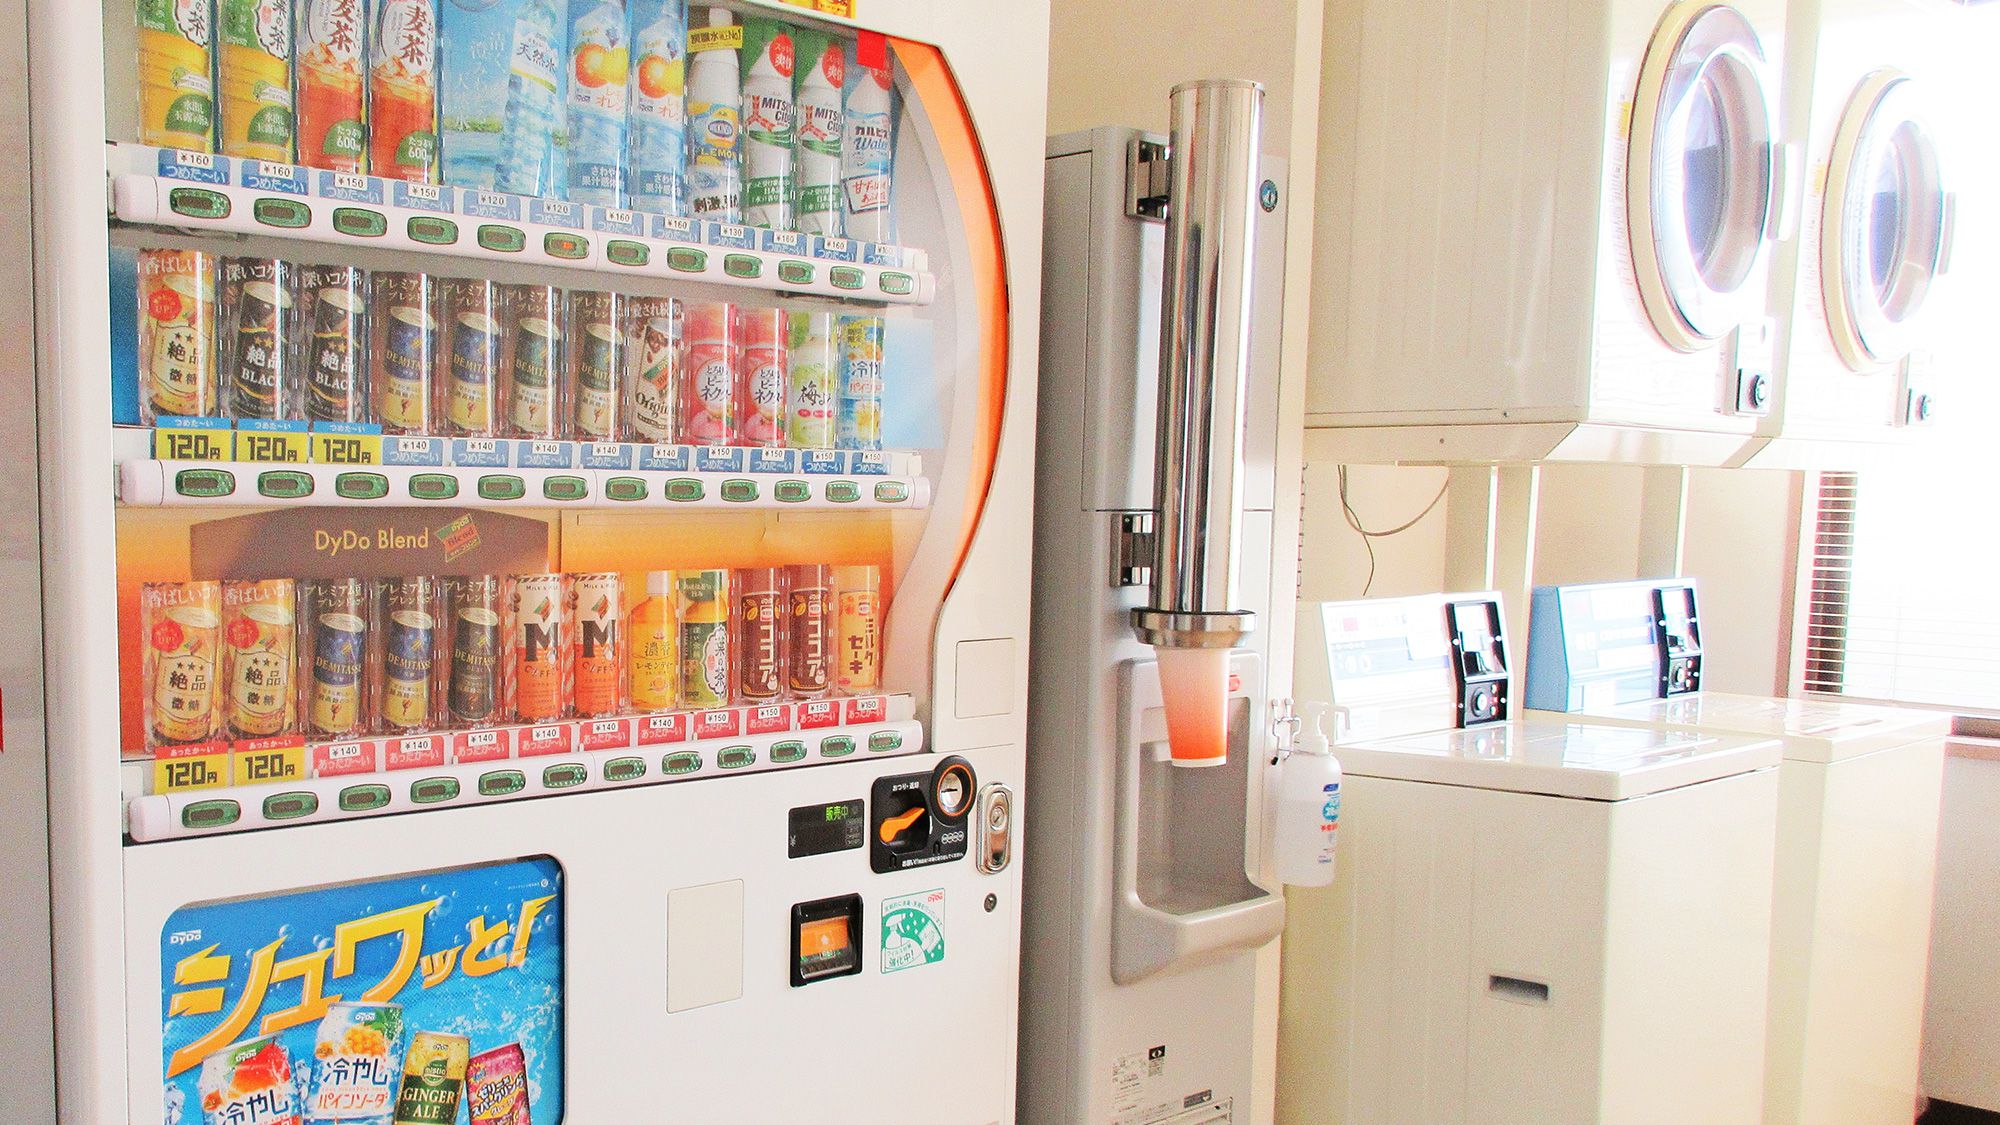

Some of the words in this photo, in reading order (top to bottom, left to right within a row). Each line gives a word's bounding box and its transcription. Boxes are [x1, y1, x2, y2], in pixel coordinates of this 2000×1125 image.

[399, 5, 427, 66] 麦茶
[180, 153, 210, 166] ¥160
[263, 165, 291, 178] ¥160
[338, 178, 364, 189] ¥150
[412, 186, 437, 198] ¥150
[481, 196, 505, 206] ¥120
[546, 203, 569, 213] ¥120
[609, 212, 630, 222] ¥160
[667, 220, 688, 230] ¥160
[722, 227, 743, 237] ¥130
[827, 241, 845, 250] ¥160
[241, 367, 276, 387] BLAC
[316, 371, 350, 391] BLAC
[167, 433, 221, 461] 120円
[247, 436, 298, 462] 120円
[323, 438, 371, 464] 120円
[402, 441, 427, 451] ¥140
[469, 442, 493, 452] ¥140
[535, 444, 557, 453] ¥140
[595, 446, 617, 455] ¥140
[711, 447, 730, 457] ¥150
[655, 448, 676, 458] ¥140
[764, 449, 783, 458] ¥150
[814, 451, 834, 461] ¥150
[315, 530, 370, 556] DyDo
[378, 527, 429, 549] Blend
[524, 622, 559, 662] M
[581, 619, 616, 658] M
[759, 624, 774, 683] ココア
[807, 620, 822, 677] ココア
[848, 635, 864, 675] セーキ
[169, 670, 207, 691] 絶品
[245, 666, 281, 686] 絶品
[760, 708, 778, 717] ¥150
[810, 704, 828, 712] ¥150
[596, 723, 616, 732] ¥140
[652, 718, 672, 727] ¥140
[471, 734, 494, 744] ¥140
[534, 729, 557, 738] ¥140
[333, 746, 357, 756] ¥140
[405, 740, 428, 750] ¥140
[245, 754, 295, 780] 120円
[166, 761, 217, 787] 120円
[170, 930, 201, 944] DyDo
[166, 895, 557, 1078] シュワッと!
[323, 1057, 388, 1086] 冷やし
[318, 1092, 389, 1110] パインソーダ
[402, 1087, 455, 1105] GINGER
[218, 1089, 289, 1125] 冷やし
[413, 1103, 440, 1119] ALE
